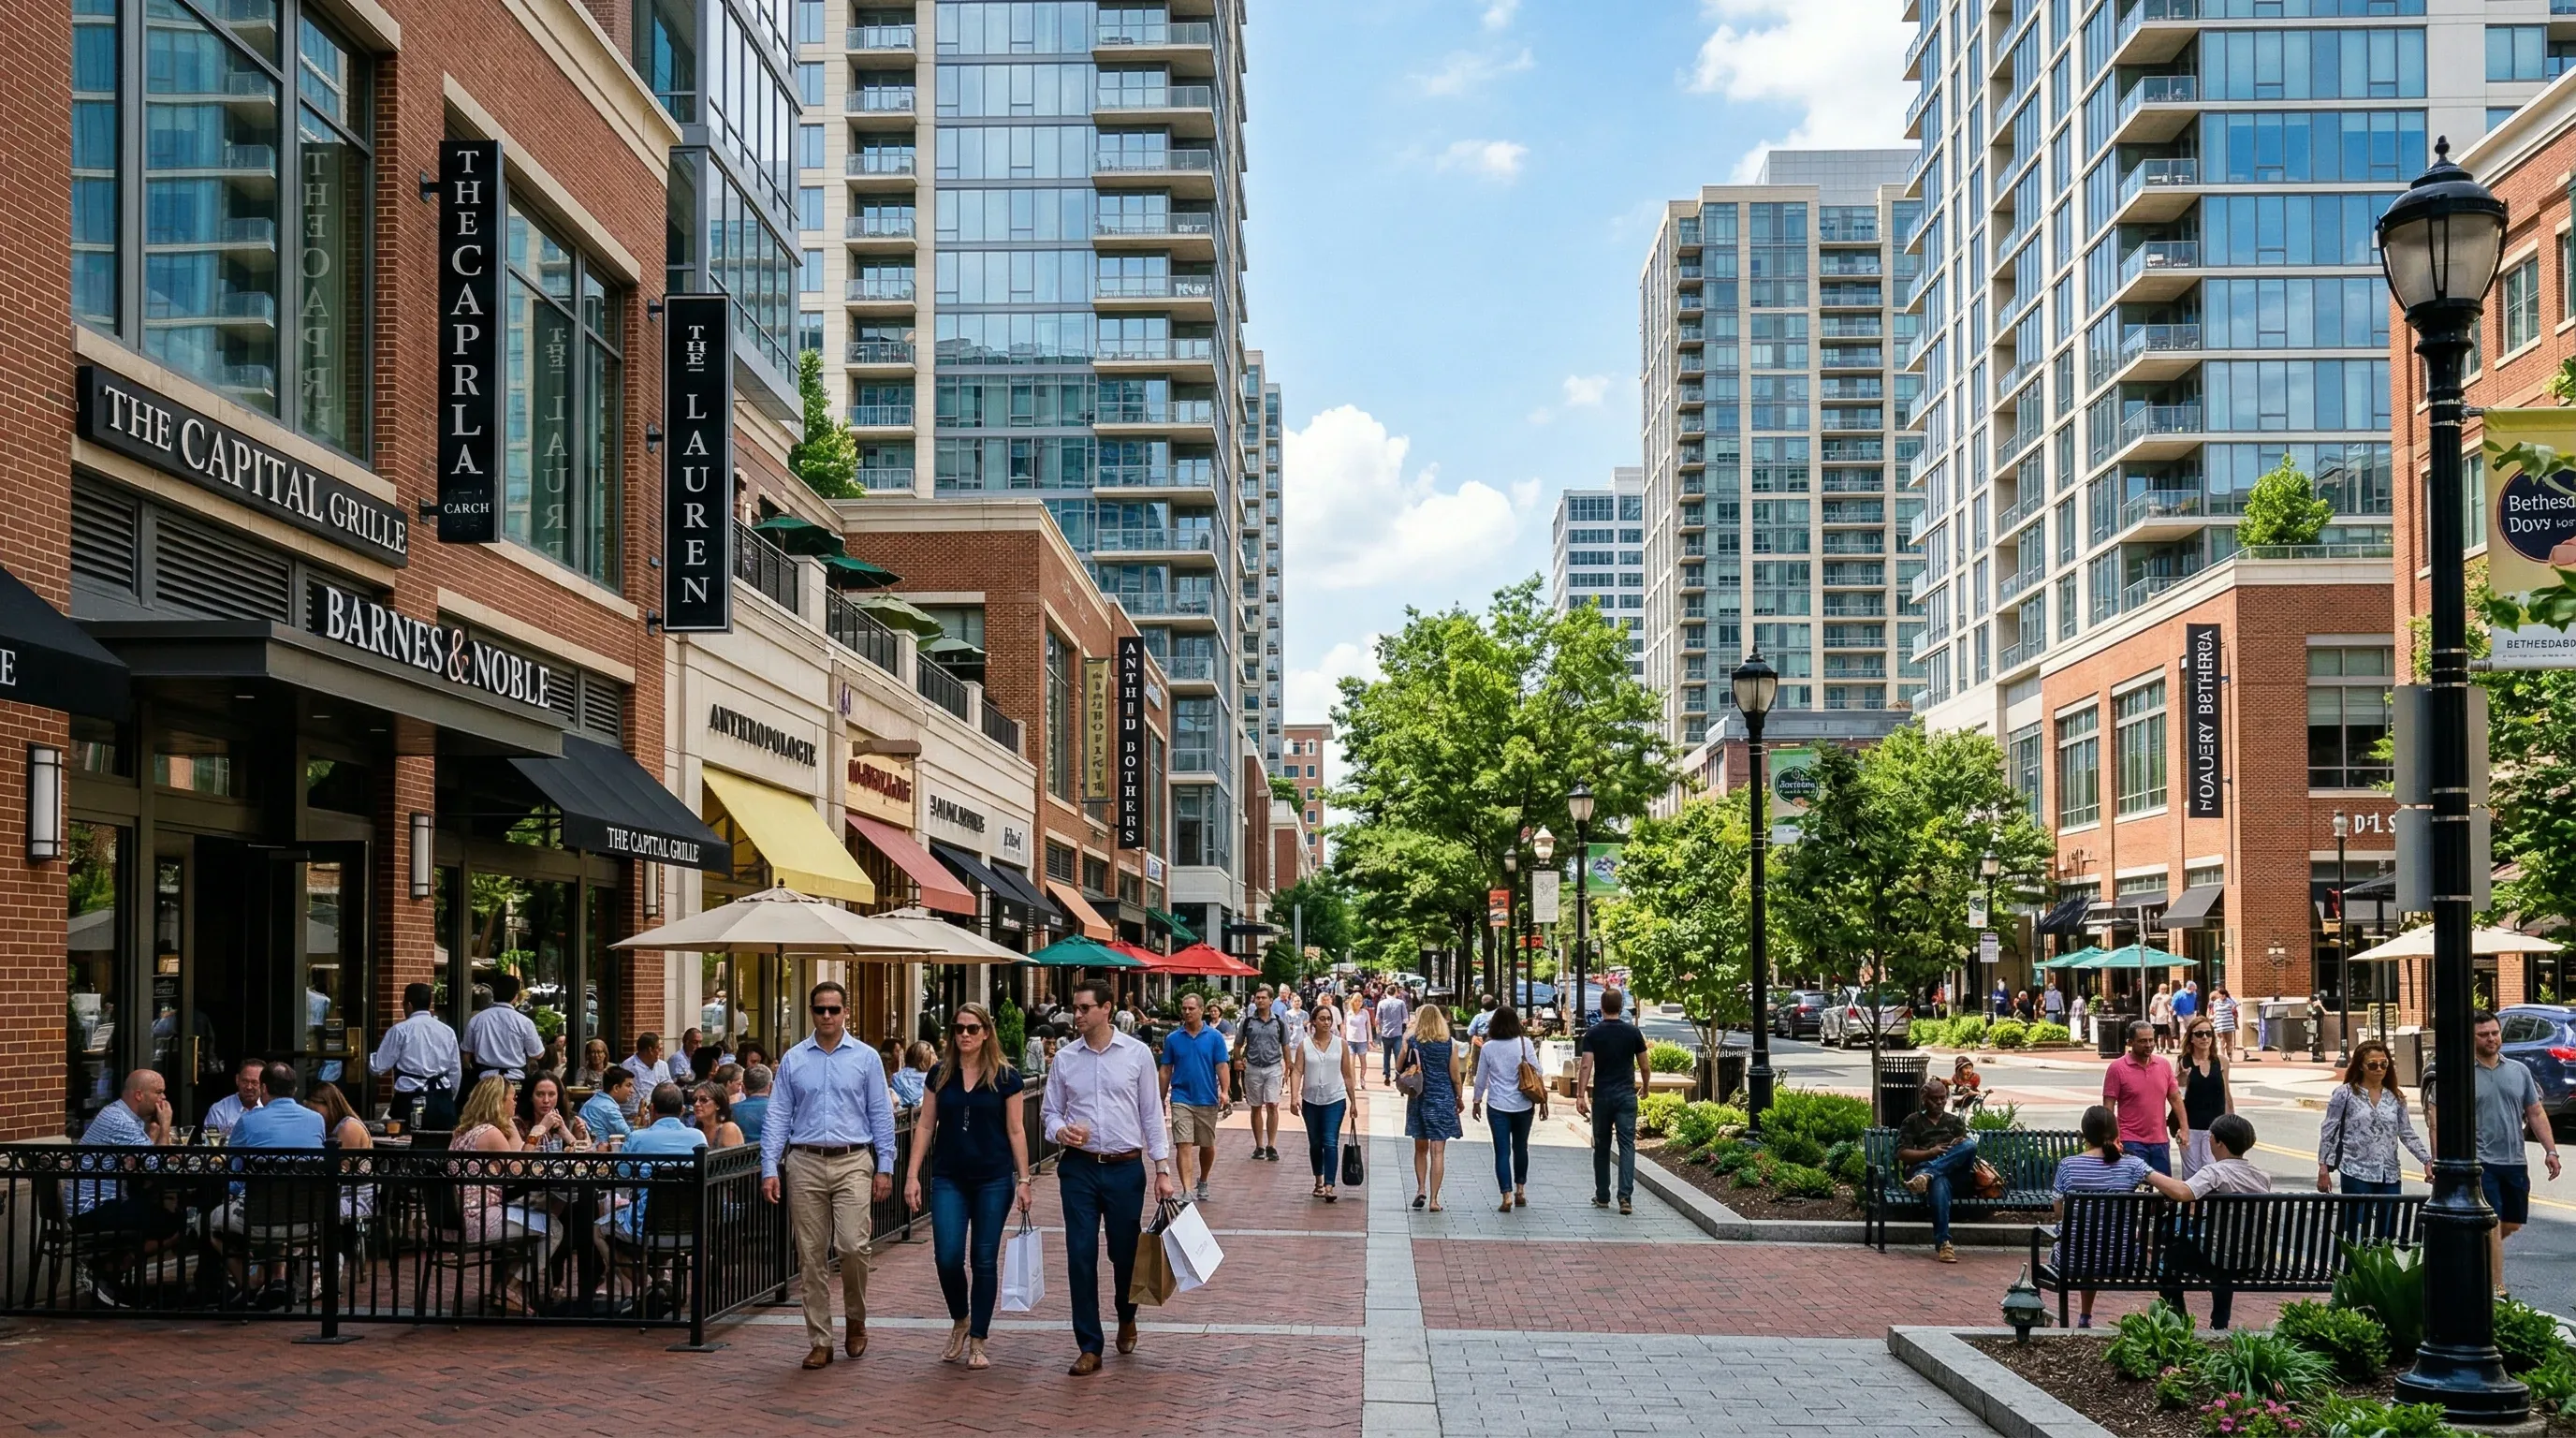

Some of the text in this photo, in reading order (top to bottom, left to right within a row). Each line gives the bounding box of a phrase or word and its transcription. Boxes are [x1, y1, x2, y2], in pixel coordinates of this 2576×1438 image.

[105, 384, 407, 555] THE CAPITAL GRILLE
[444, 503, 490, 514] CARCH
[681, 325, 710, 604] THE LAUREN
[2510, 516, 2552, 533] Dovy
[326, 586, 550, 709] BARNES & NOBLE
[1123, 741, 1136, 842] BOTHERS
[607, 827, 700, 863] THE CAPITAL GRILLE
